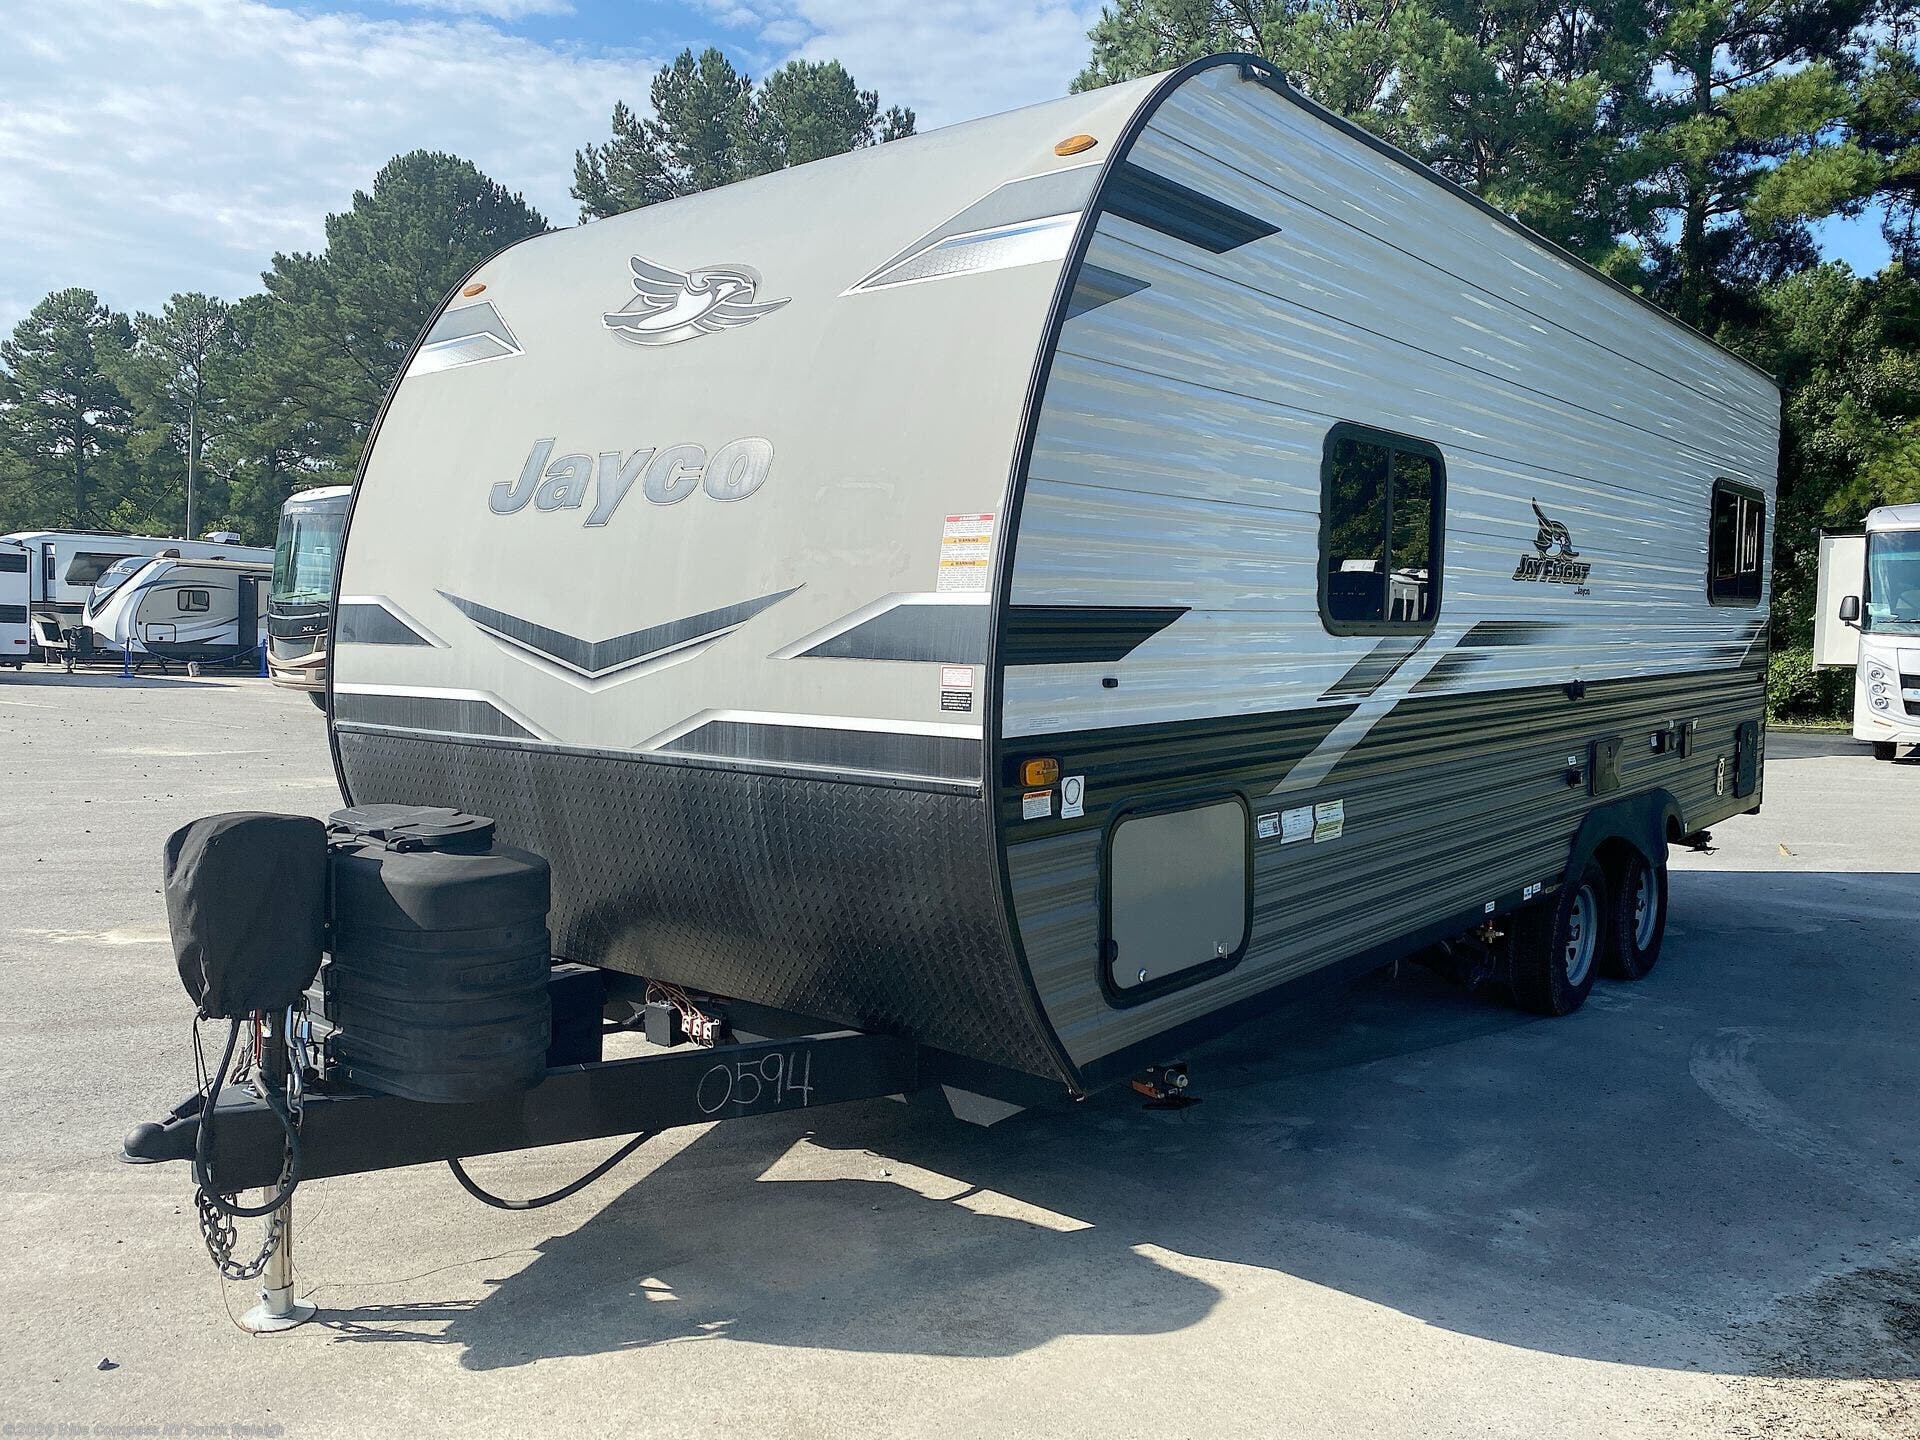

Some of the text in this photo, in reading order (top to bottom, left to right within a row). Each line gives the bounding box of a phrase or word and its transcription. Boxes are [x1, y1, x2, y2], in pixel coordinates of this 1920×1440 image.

[488, 436, 775, 528] Jayco
[1512, 554, 1592, 585] JAY FLIGHT
[1574, 586, 1591, 596] Jayco
[697, 1049, 814, 1114] 0594
